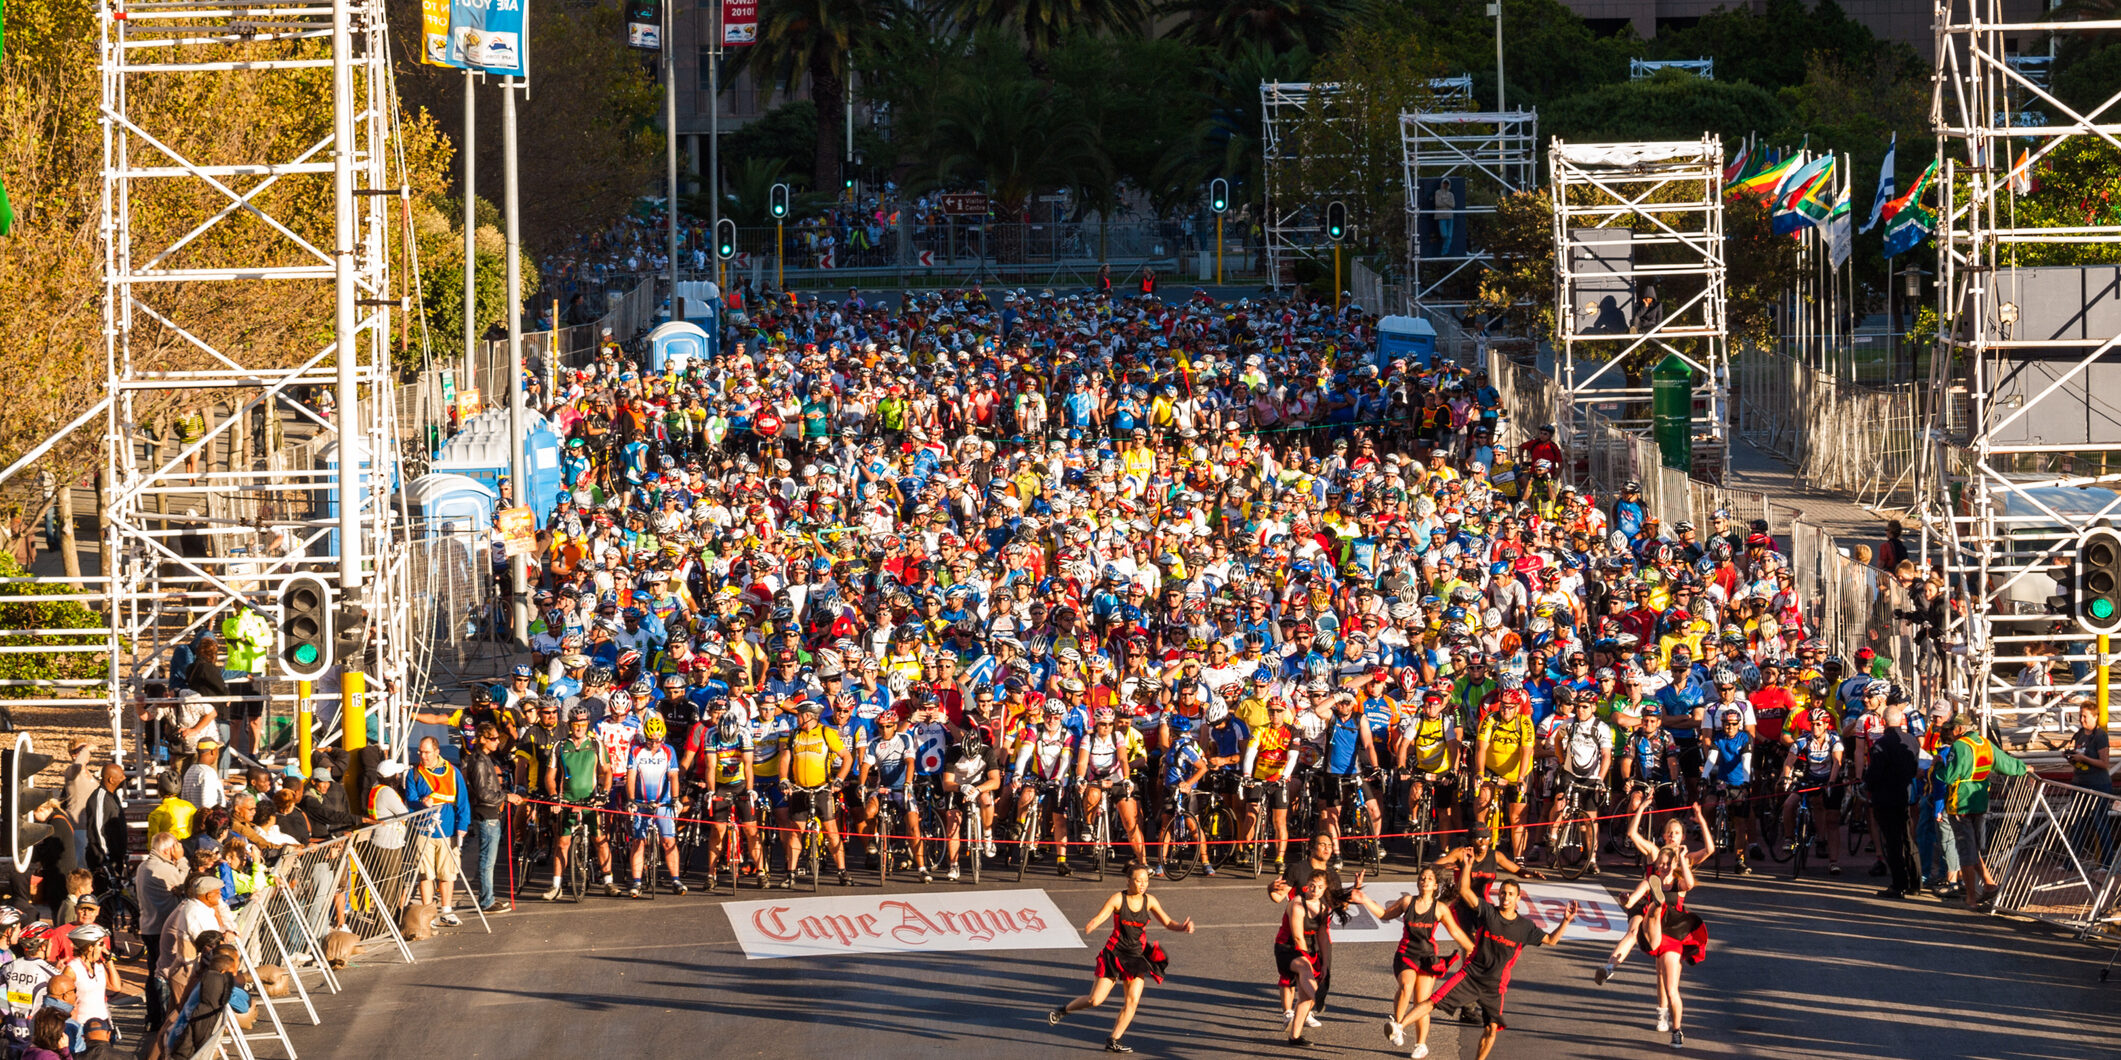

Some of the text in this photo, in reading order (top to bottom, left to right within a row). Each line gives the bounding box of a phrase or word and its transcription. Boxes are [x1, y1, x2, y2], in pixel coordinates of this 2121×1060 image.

[352, 694, 363, 706] 15
[638, 757, 665, 765] SKF
[1498, 889, 1611, 932] ay
[751, 900, 1048, 947] Cape Argus
[6, 971, 39, 984] sappi
